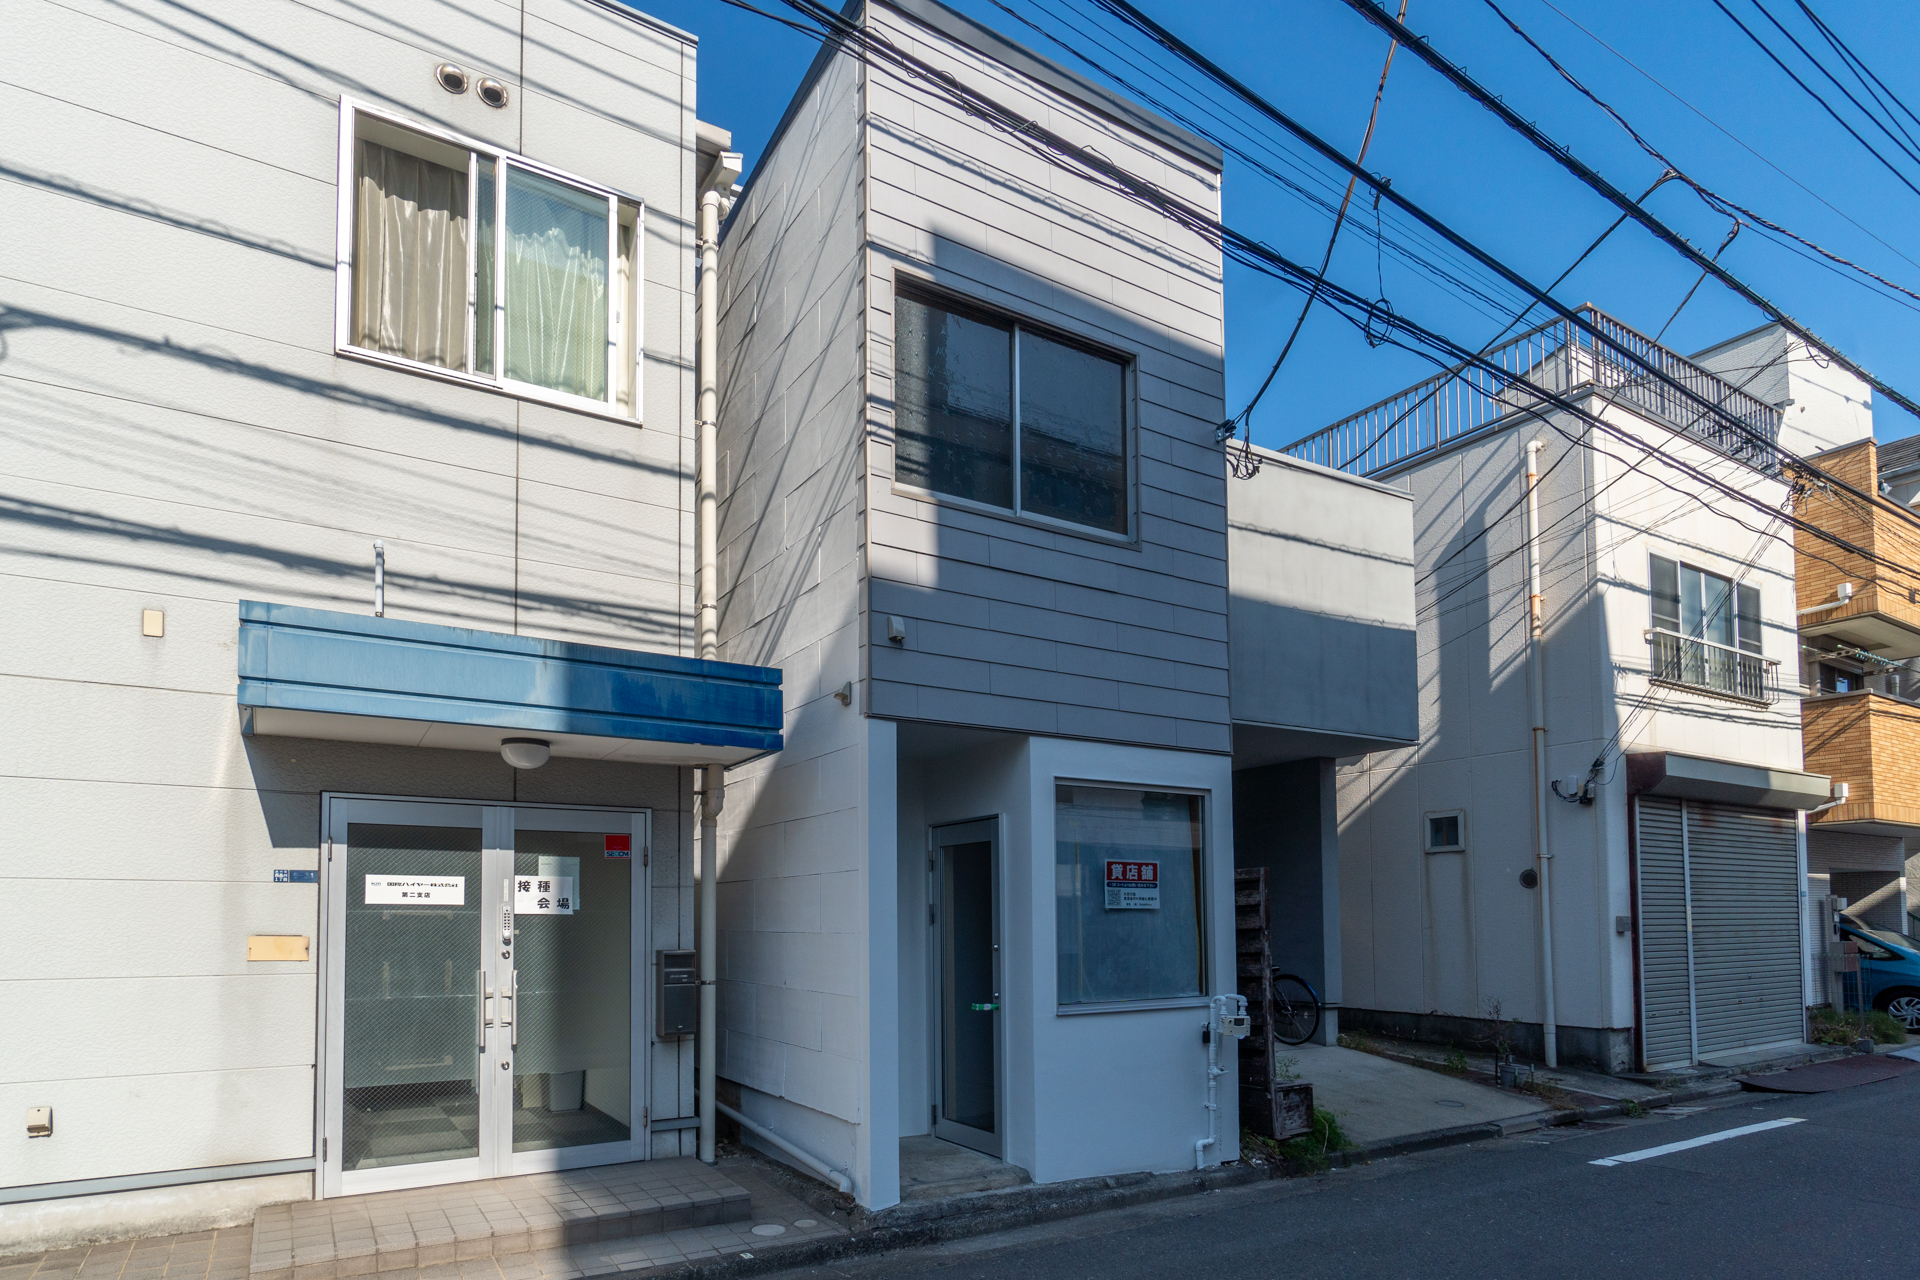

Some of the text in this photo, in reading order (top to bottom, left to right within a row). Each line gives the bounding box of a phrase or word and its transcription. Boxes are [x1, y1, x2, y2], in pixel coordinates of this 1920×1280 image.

[1110, 863, 1154, 880] 貸店舗
[517, 880, 551, 893] 接種
[401, 891, 431, 899] 第二支店
[537, 897, 570, 910] 会場
